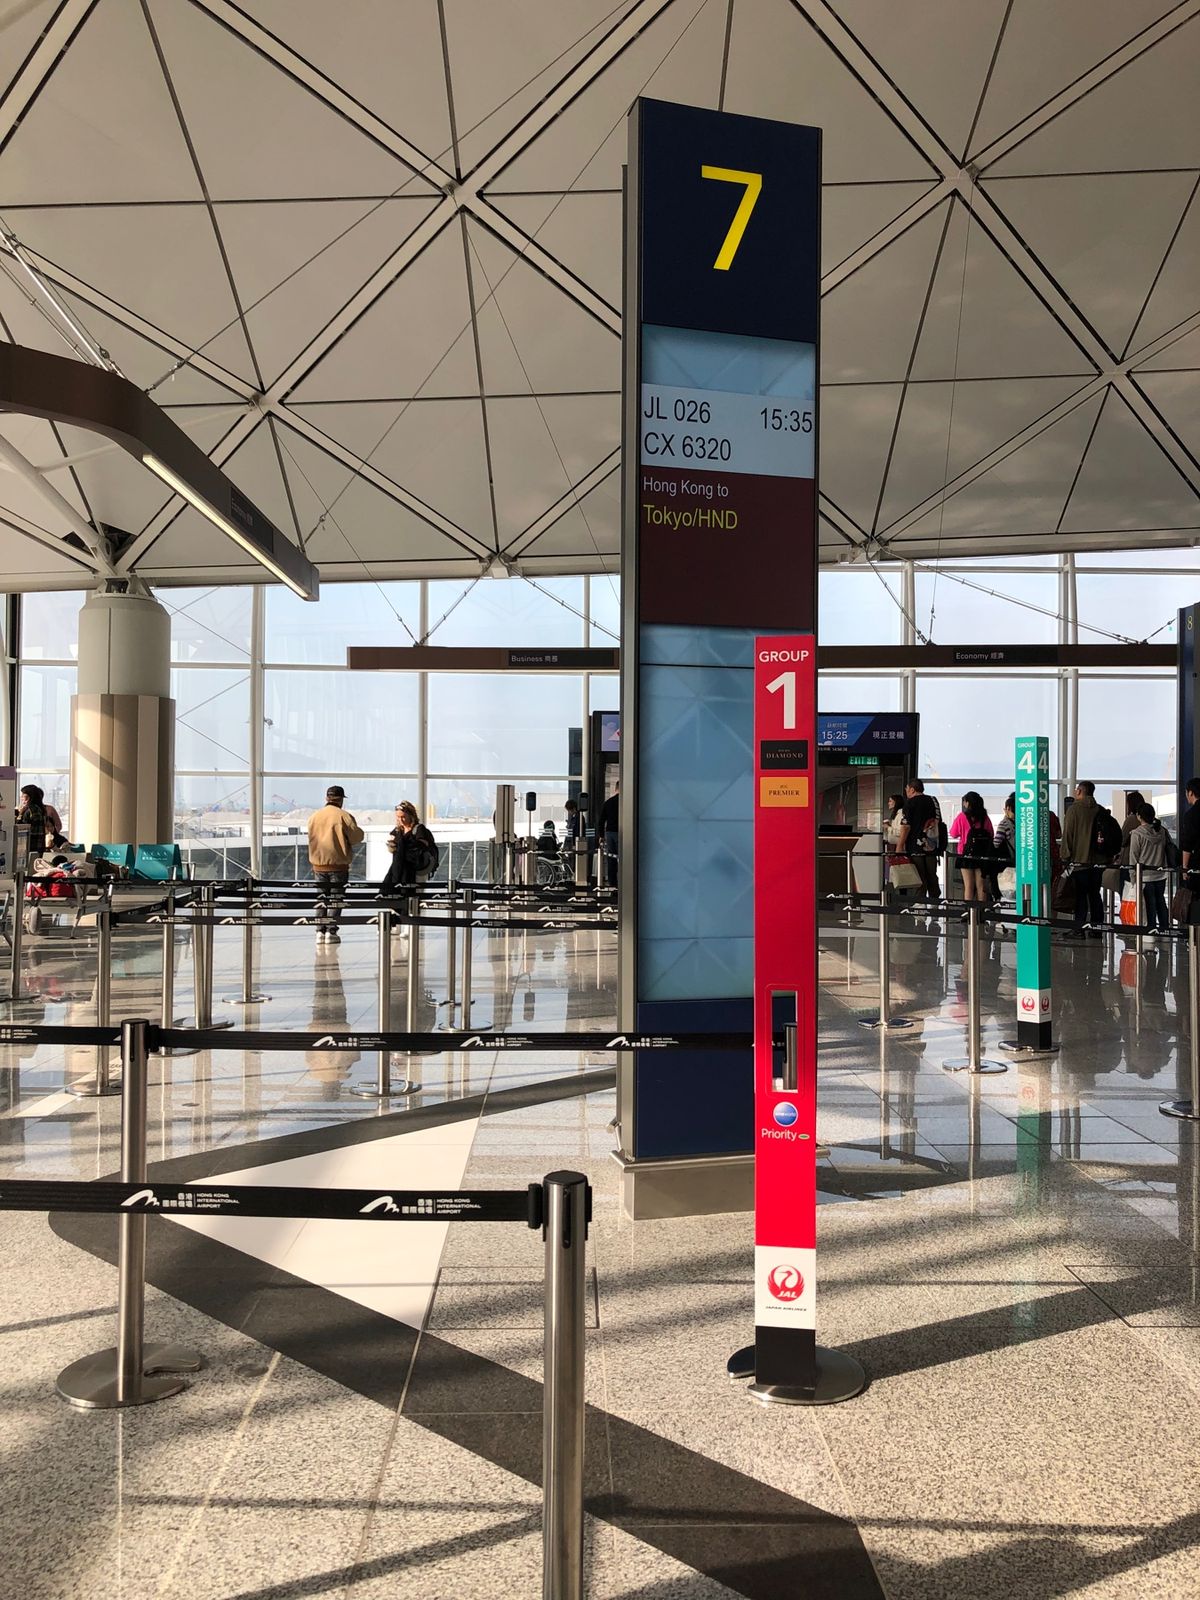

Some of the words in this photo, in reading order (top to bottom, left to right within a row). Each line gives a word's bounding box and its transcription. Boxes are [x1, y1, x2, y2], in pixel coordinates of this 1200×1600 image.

[701, 164, 763, 271] 7
[643, 396, 667, 419] JL
[673, 399, 711, 424] 026
[760, 407, 813, 433] 15:35
[644, 432, 675, 457] CX
[682, 435, 731, 461] 6320
[643, 476, 677, 496] Hong
[681, 480, 713, 500] Kong
[717, 483, 729, 497] to
[643, 504, 738, 530] Tokyo/HND
[1186, 615, 1193, 630] 8
[758, 650, 809, 663] GROUP
[955, 652, 989, 660] Economy
[765, 671, 796, 730] 1
[822, 731, 848, 740] 15:25
[849, 757, 865, 765] EXIT
[1017, 750, 1035, 774] 4
[1038, 750, 1048, 774] 4
[1018, 780, 1035, 804] 5
[1038, 780, 1048, 804] 5
[1026, 806, 1034, 851] ECONOMY
[761, 1127, 797, 1142] Priority
